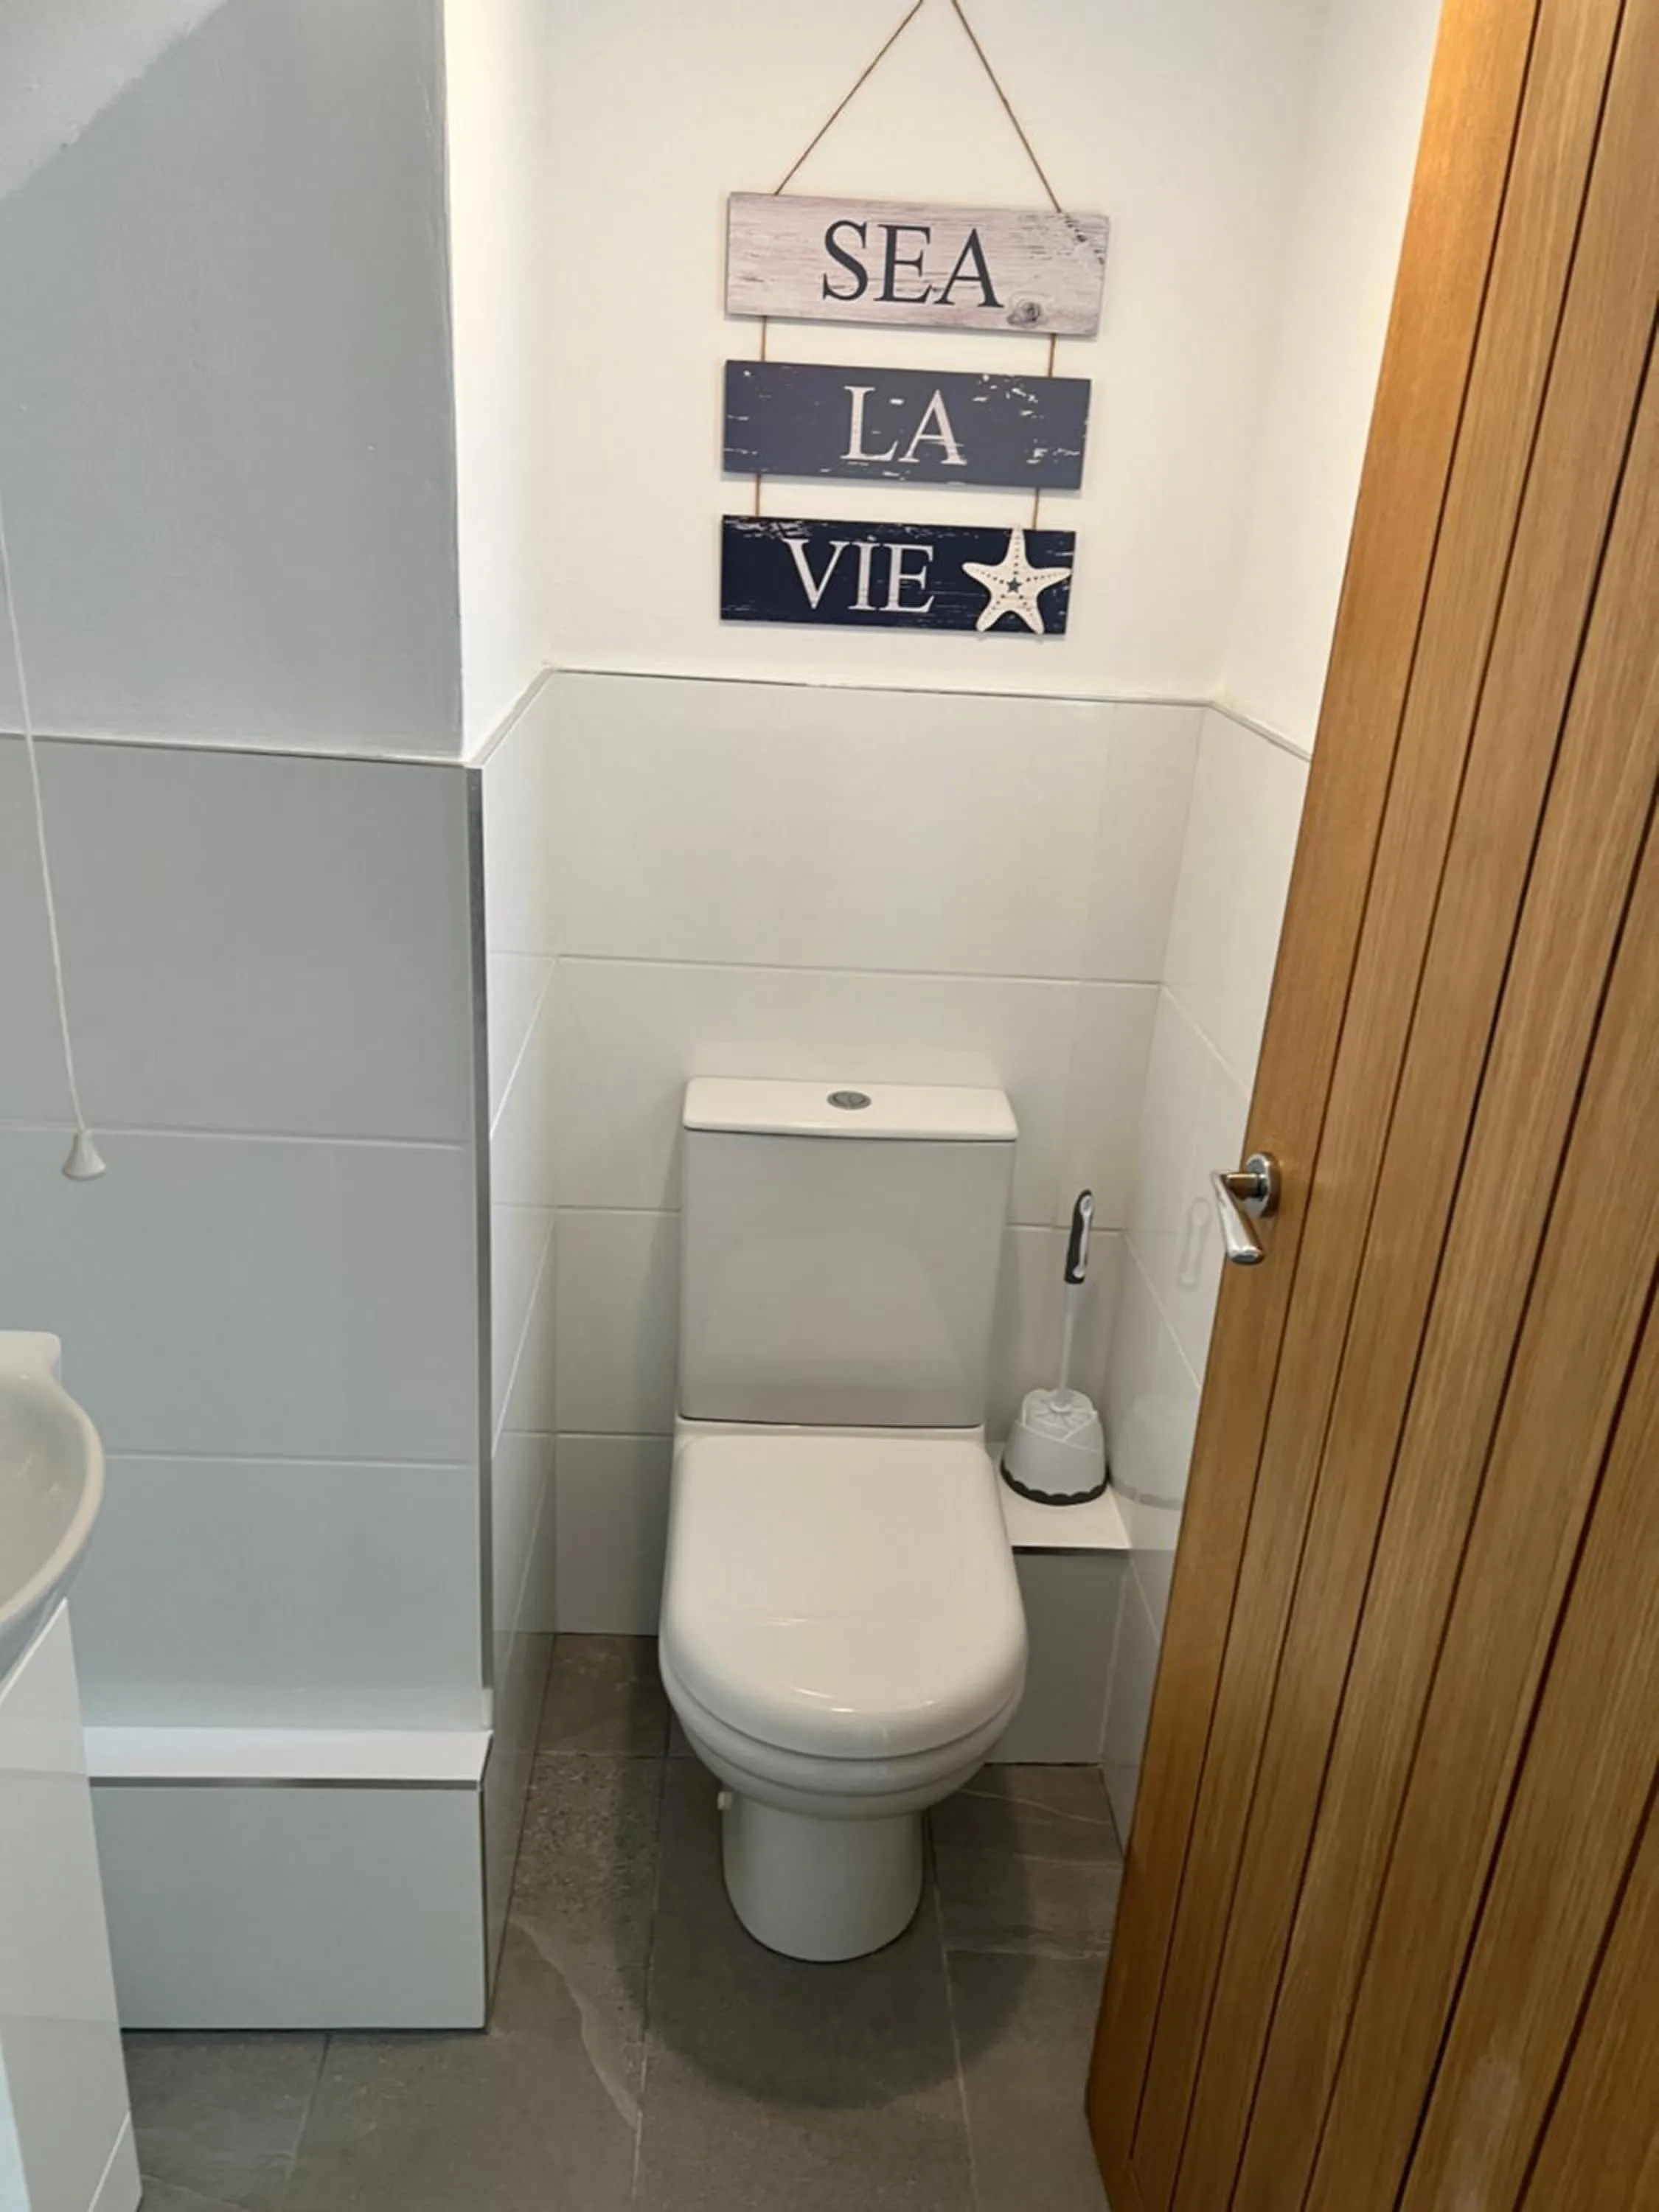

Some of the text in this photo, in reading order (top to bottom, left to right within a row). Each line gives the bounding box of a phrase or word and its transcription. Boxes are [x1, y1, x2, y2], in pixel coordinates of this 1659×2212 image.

[822, 220, 1004, 307] SEA
[841, 386, 967, 466] LA
[782, 538, 935, 613] VIE
